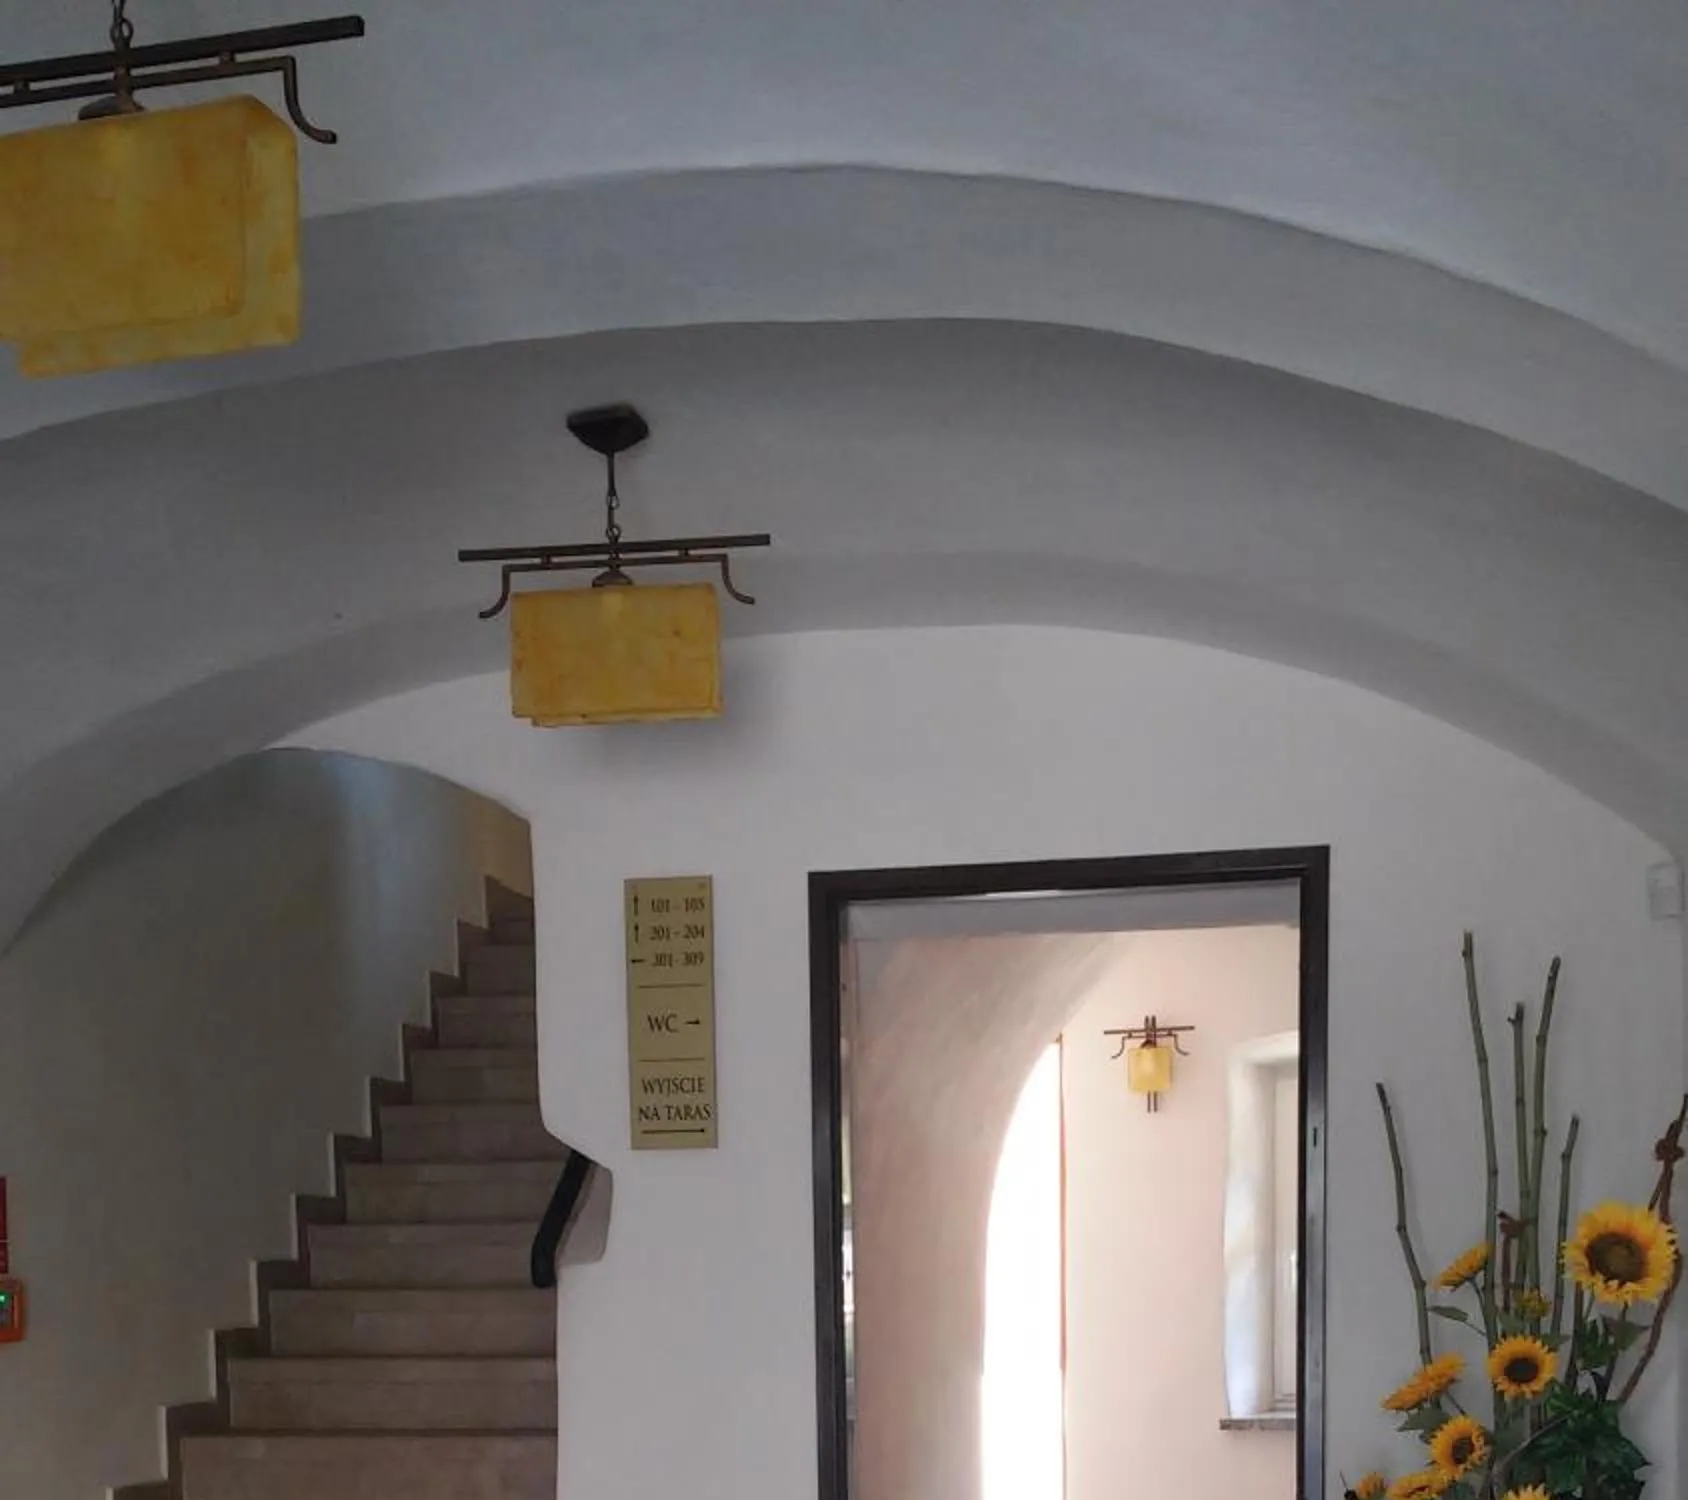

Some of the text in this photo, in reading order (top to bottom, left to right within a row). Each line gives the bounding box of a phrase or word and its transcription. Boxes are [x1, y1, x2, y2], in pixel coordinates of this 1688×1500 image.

[650, 925, 671, 941] 201
[682, 924, 705, 940] 204
[647, 1013, 679, 1033] WC
[638, 1103, 712, 1121] NA TARAS
